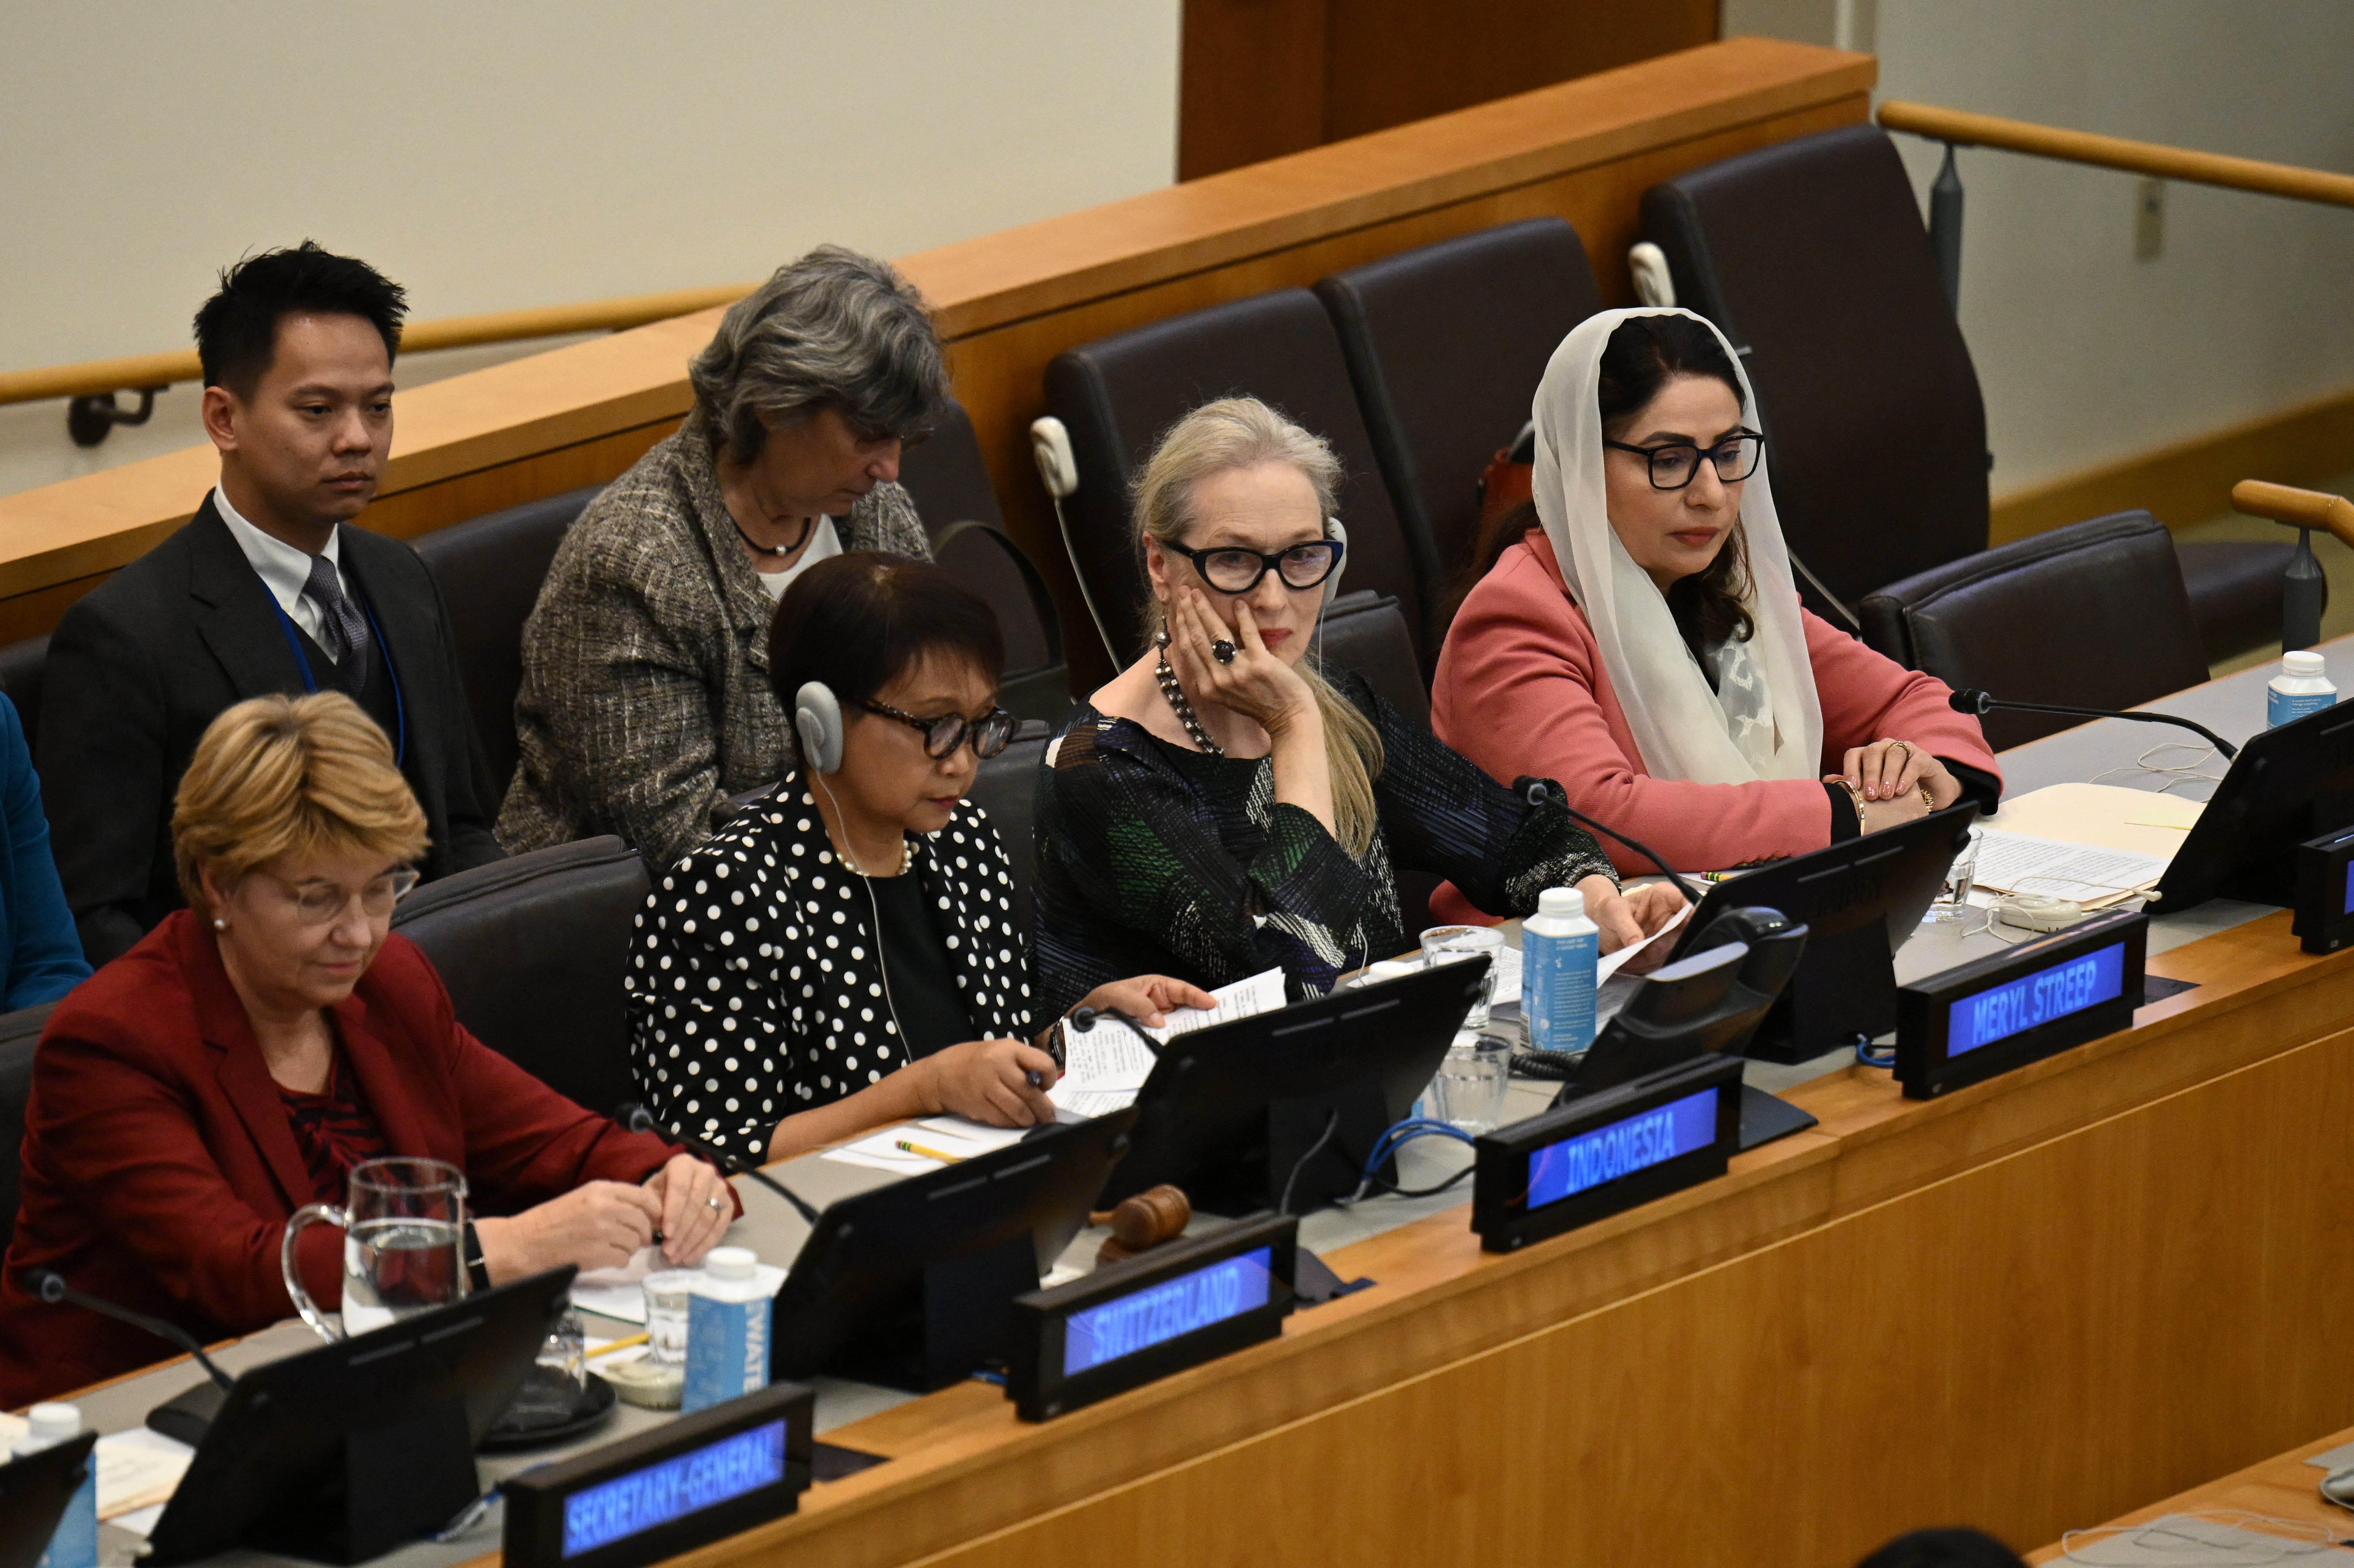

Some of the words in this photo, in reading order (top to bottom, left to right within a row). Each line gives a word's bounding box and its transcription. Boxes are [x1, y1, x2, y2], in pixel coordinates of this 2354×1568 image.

[1972, 985, 2028, 1043] MERYL
[2033, 961, 2096, 1022] STREEP
[1566, 1111, 1675, 1193] INDONESIA
[1092, 1267, 1240, 1365] SWITZERLAND
[567, 1429, 775, 1544] SECRETARY-GENERAL
